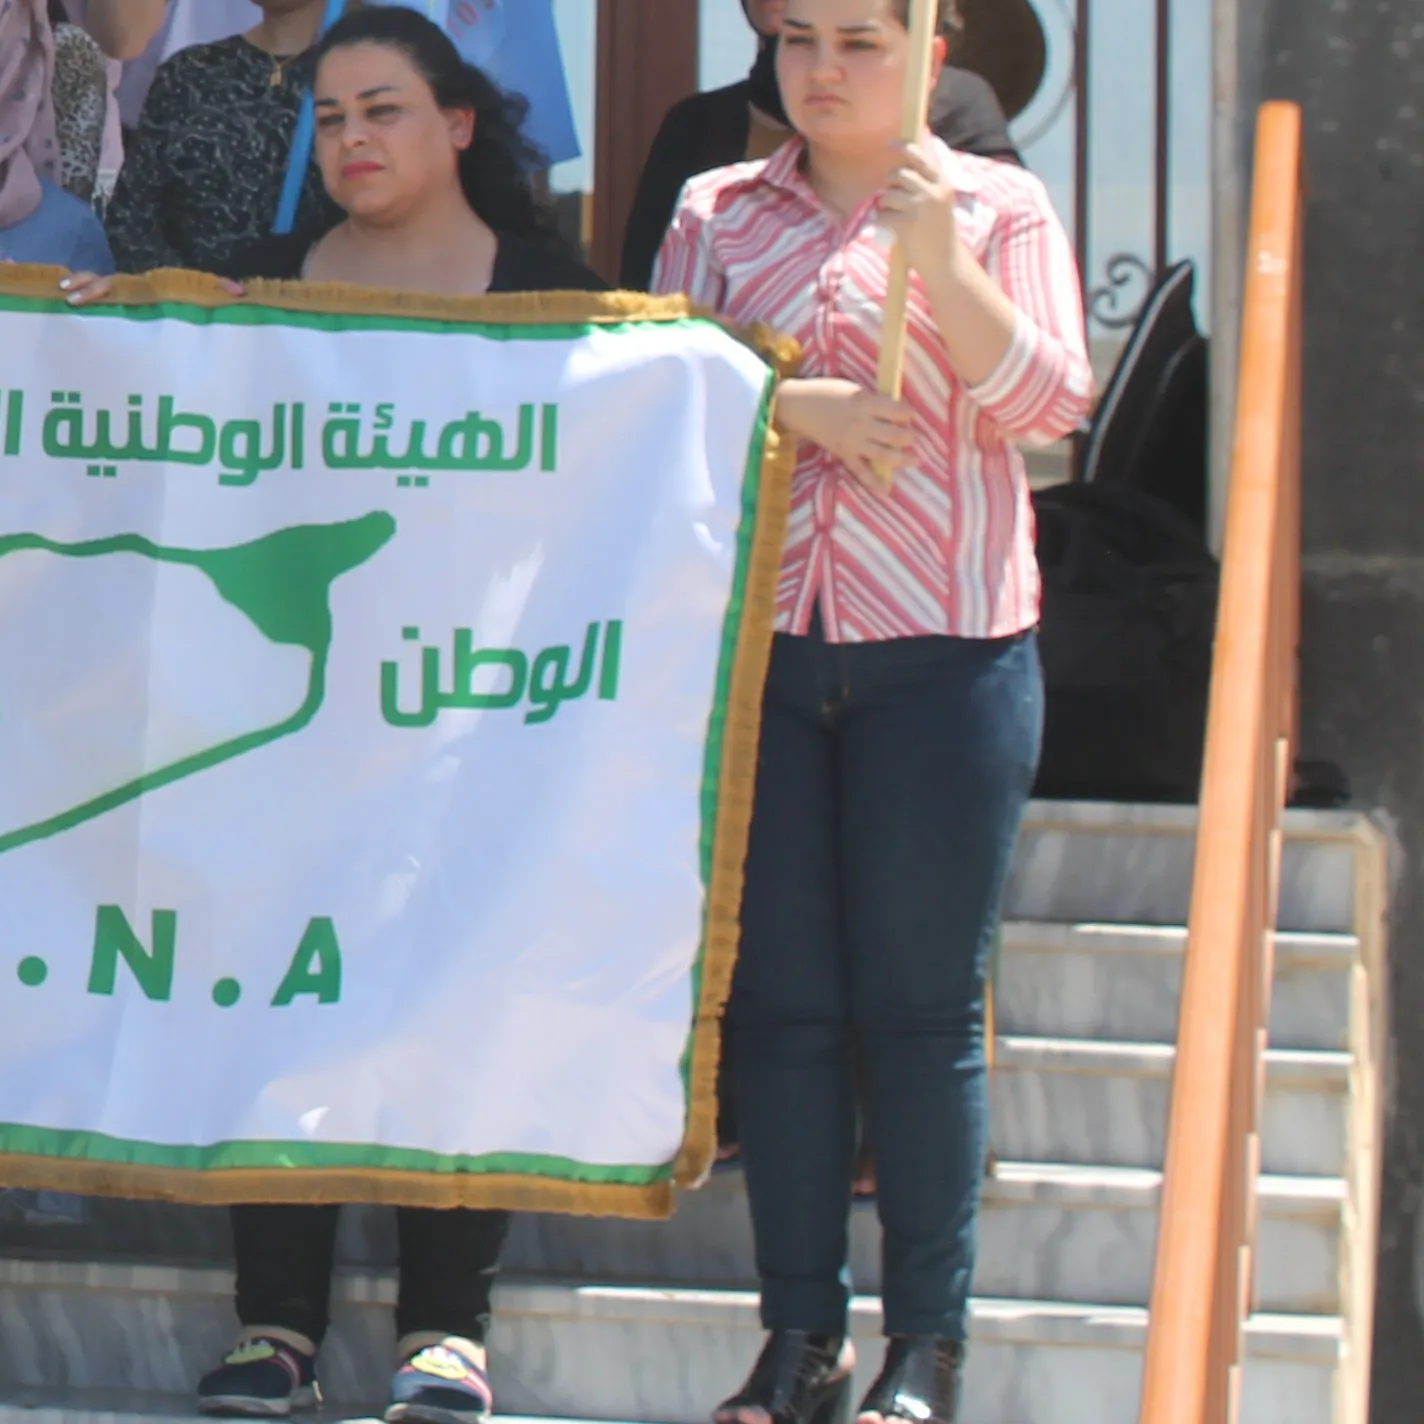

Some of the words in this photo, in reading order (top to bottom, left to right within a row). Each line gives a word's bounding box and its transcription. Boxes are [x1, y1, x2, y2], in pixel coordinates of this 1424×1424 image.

[41, 389, 305, 486] الوطنية
[320, 401, 559, 486] الهيئة
[379, 619, 623, 728] الوطن
